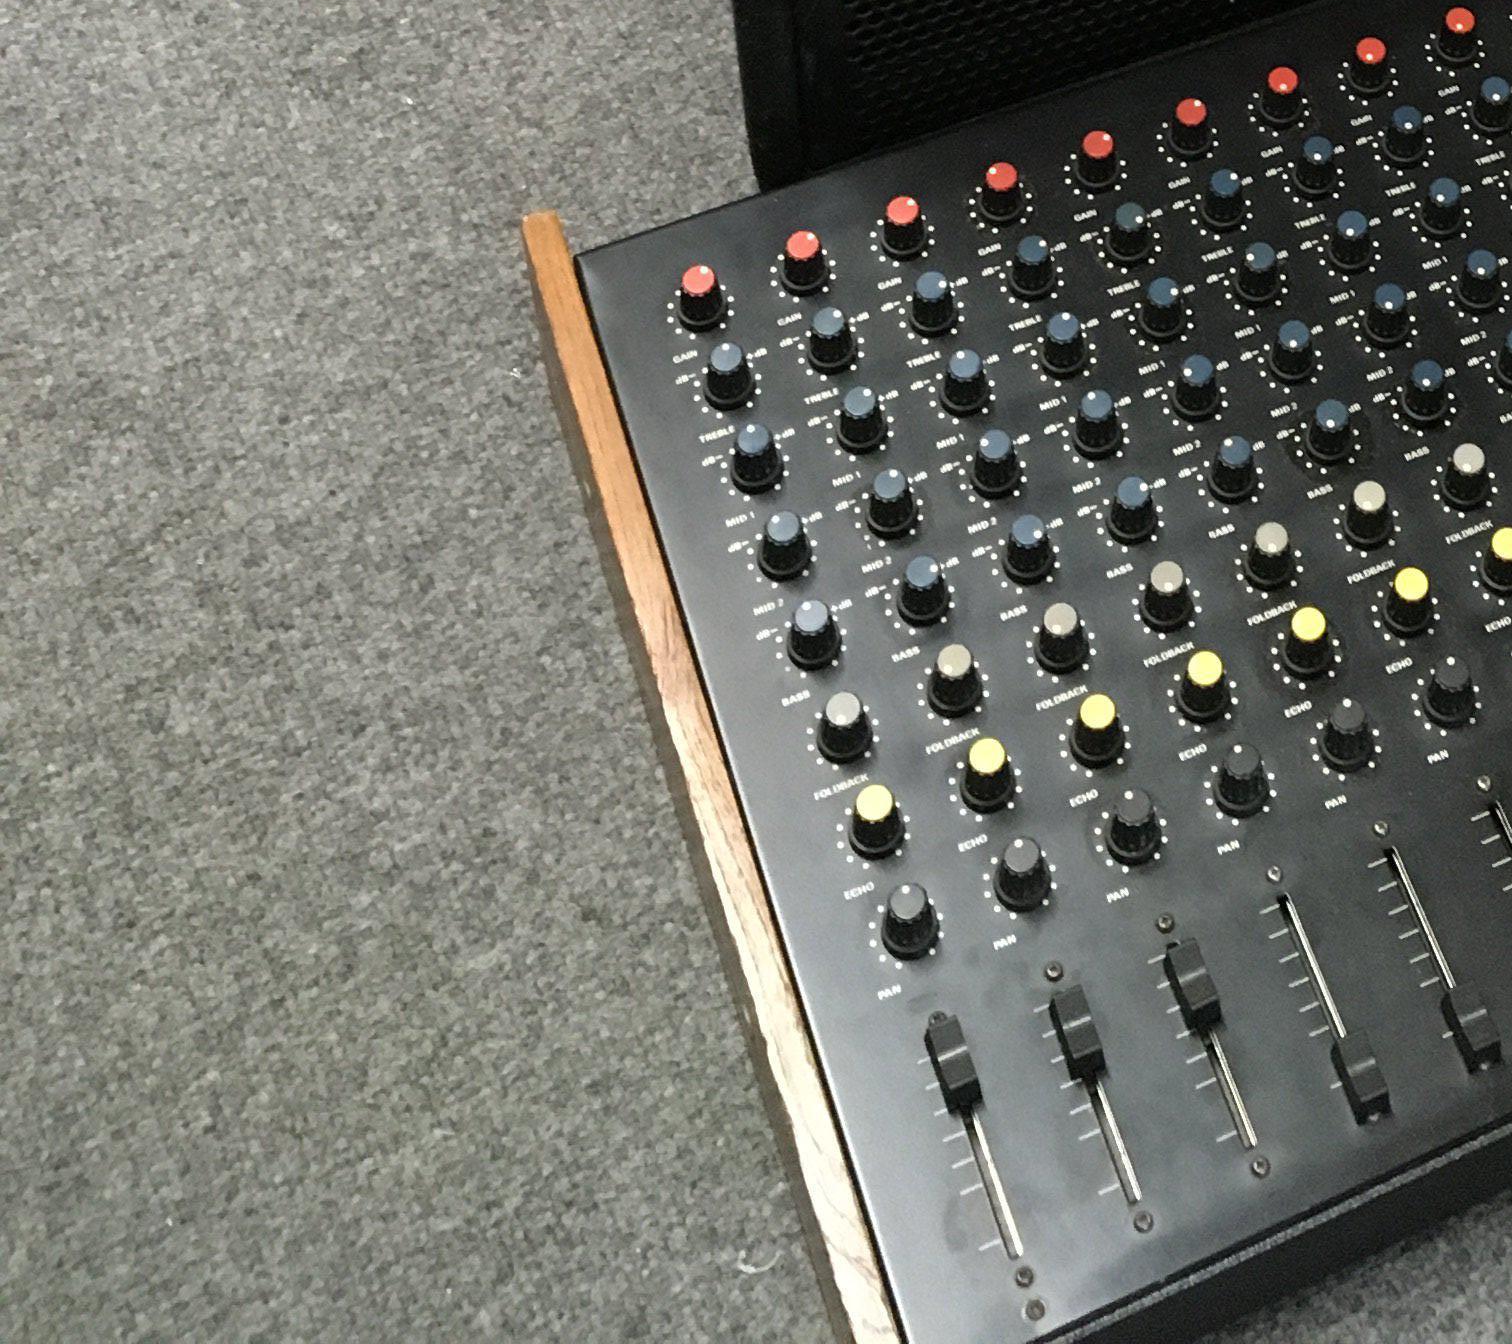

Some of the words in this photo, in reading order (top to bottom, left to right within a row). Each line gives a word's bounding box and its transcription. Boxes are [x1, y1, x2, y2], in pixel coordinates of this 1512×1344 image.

[978, 243, 1001, 256] GAIN
[878, 277, 902, 290] GAIN
[777, 313, 801, 326] GAIN
[673, 350, 697, 363] GAIN
[1307, 484, 1333, 499] BASS
[1209, 524, 1235, 538] BASS
[1446, 520, 1493, 544] FOLDBACK
[1107, 563, 1133, 578] BASS
[1347, 560, 1396, 585] FOLDBACK
[1000, 605, 1027, 621] BASS
[1247, 600, 1297, 627] FOLDBACK
[1485, 617, 1511, 632] ECHO
[892, 647, 920, 662] BASS
[1144, 642, 1195, 669] FOLDBACK
[1386, 657, 1412, 674] ECHO
[782, 690, 810, 706] BASS
[1037, 685, 1088, 712] FOLDBACK
[1285, 701, 1312, 718] ECHO
[926, 728, 980, 756] FOLDBACK
[1179, 744, 1207, 761] ECHO
[1427, 750, 1448, 764] PAN
[814, 774, 868, 800] FOLDBACK
[1070, 789, 1098, 807] ECHO
[958, 834, 987, 852] ECHO
[1217, 840, 1239, 855] PAN
[844, 882, 874, 900] ECHO
[1106, 888, 1129, 903] PAN
[993, 935, 1016, 950] PAN
[878, 984, 901, 1000] PAN
